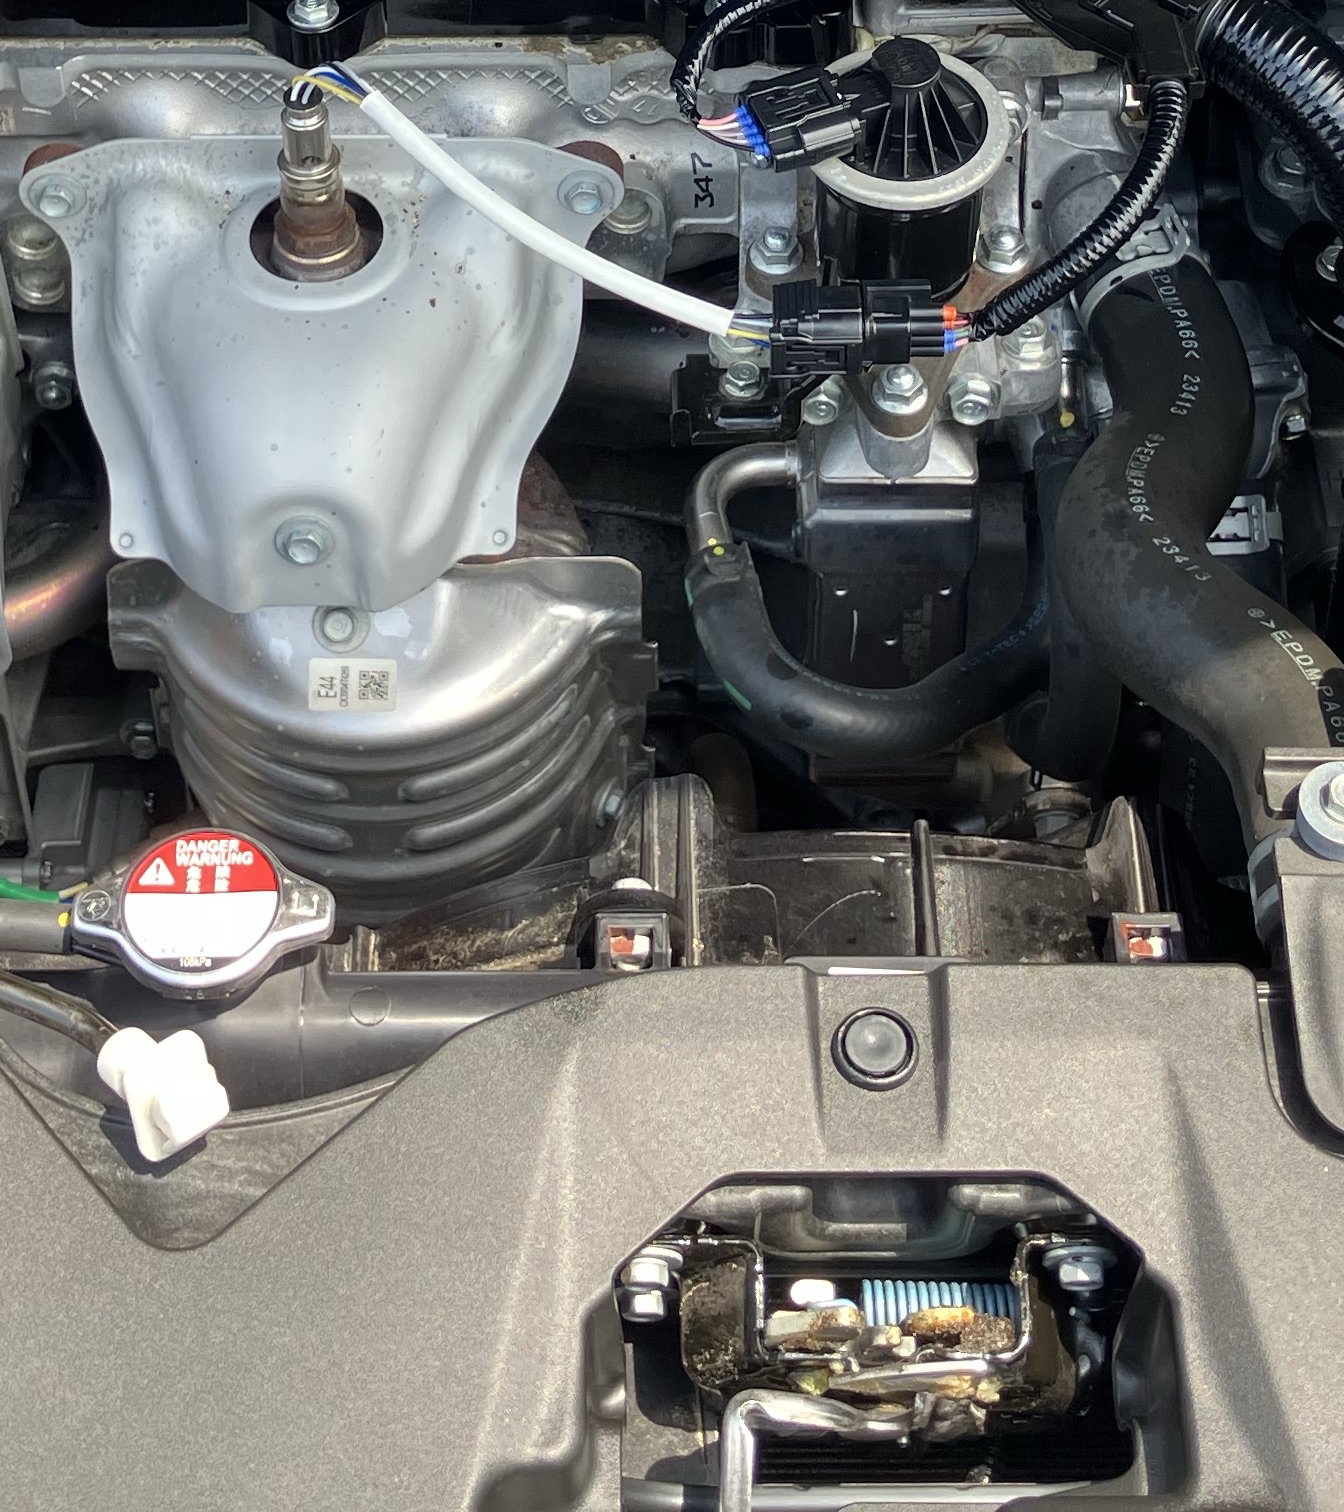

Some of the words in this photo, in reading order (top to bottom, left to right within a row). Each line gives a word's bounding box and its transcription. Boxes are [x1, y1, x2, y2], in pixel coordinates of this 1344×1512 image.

[690, 152, 715, 208] 347
[1169, 373, 1201, 416] 23413
[1152, 536, 1213, 582] 23413
[317, 675, 338, 699] E44
[175, 839, 241, 853] DANGER
[175, 851, 254, 866] WARNUNG
